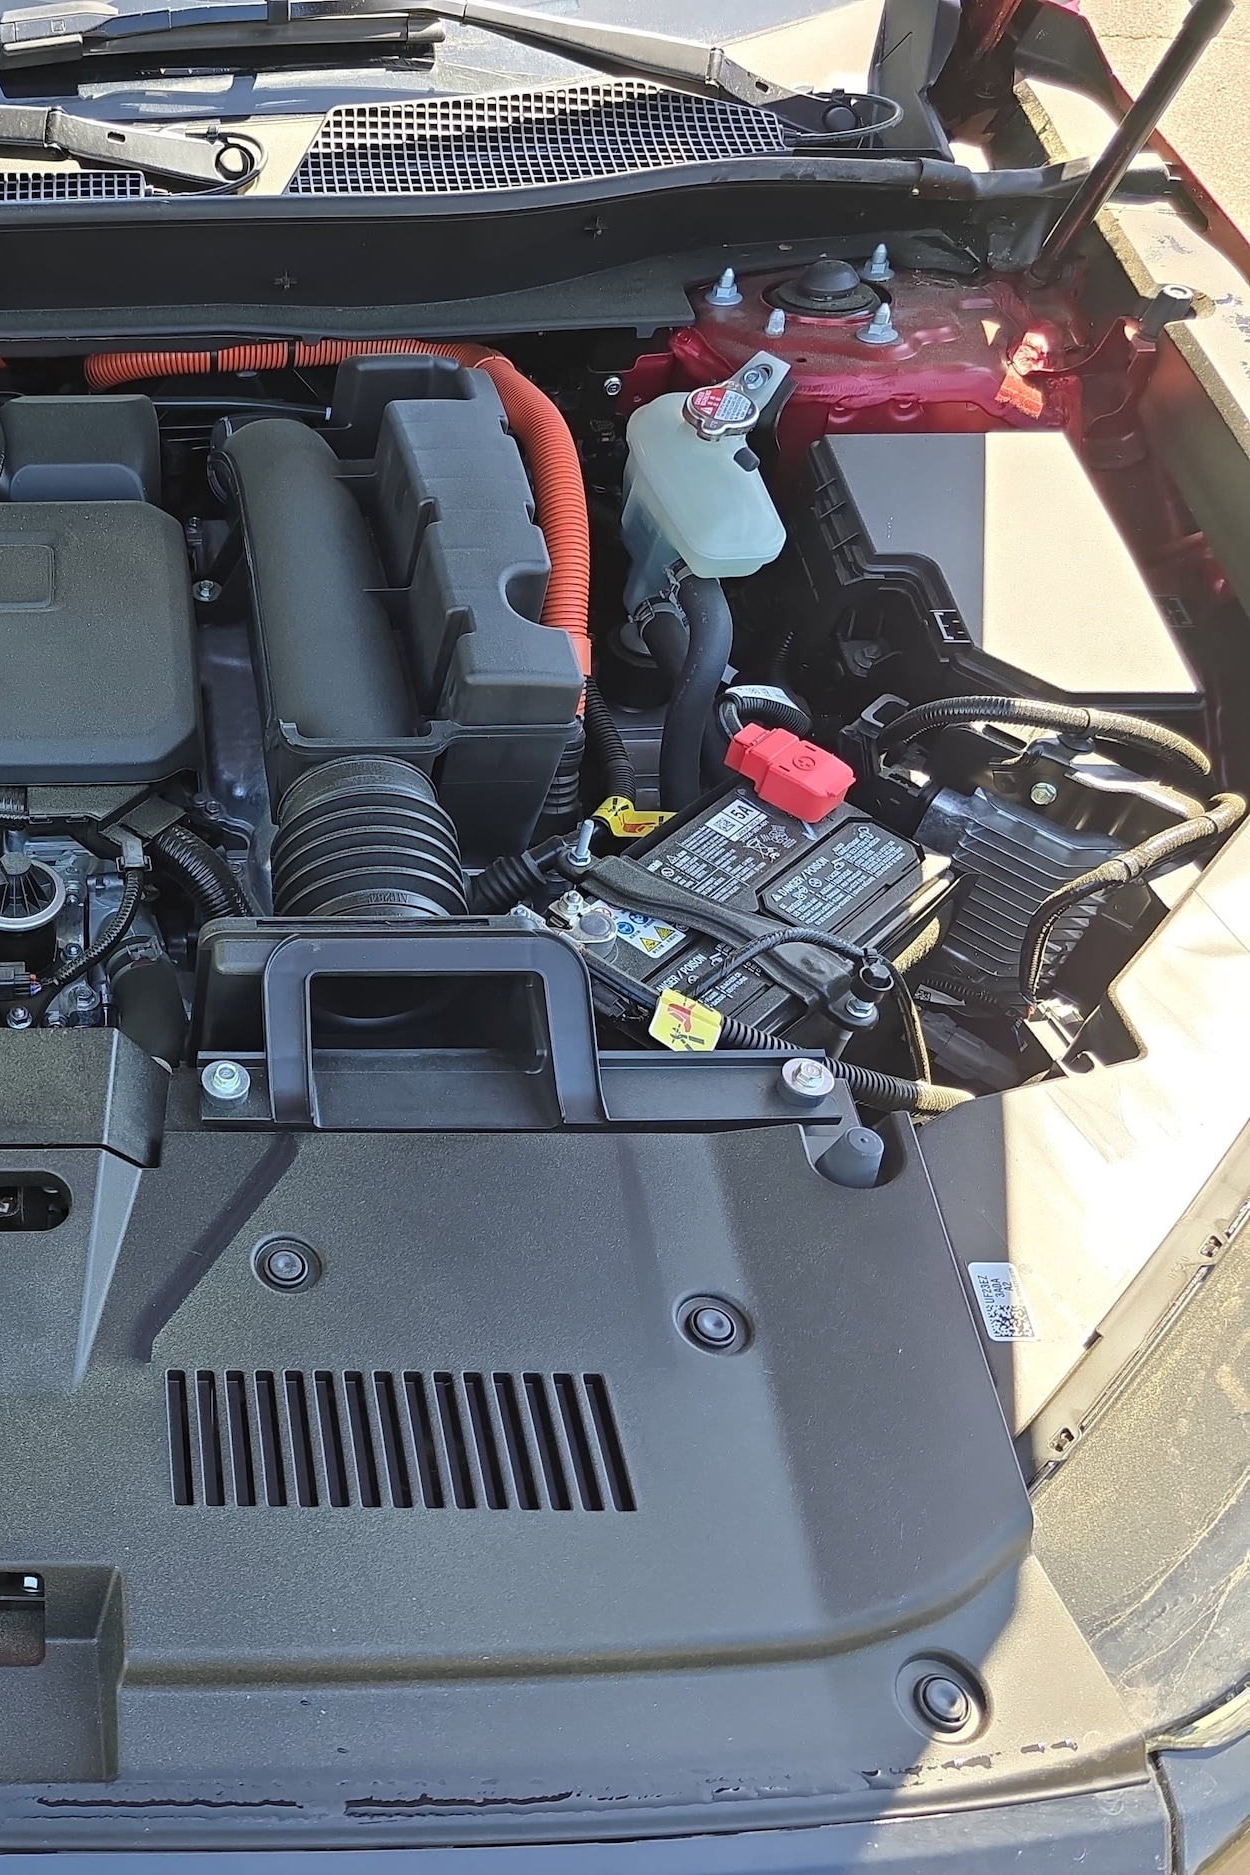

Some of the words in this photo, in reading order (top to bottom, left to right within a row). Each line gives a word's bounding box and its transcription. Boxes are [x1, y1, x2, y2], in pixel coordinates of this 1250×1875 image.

[730, 804, 754, 820] 5A
[777, 875, 805, 897] DANGER
[806, 856, 830, 876] POISON
[681, 953, 707, 975] POISON
[978, 1275, 995, 1304] UF23EZ
[1001, 1281, 1014, 1292] A2
